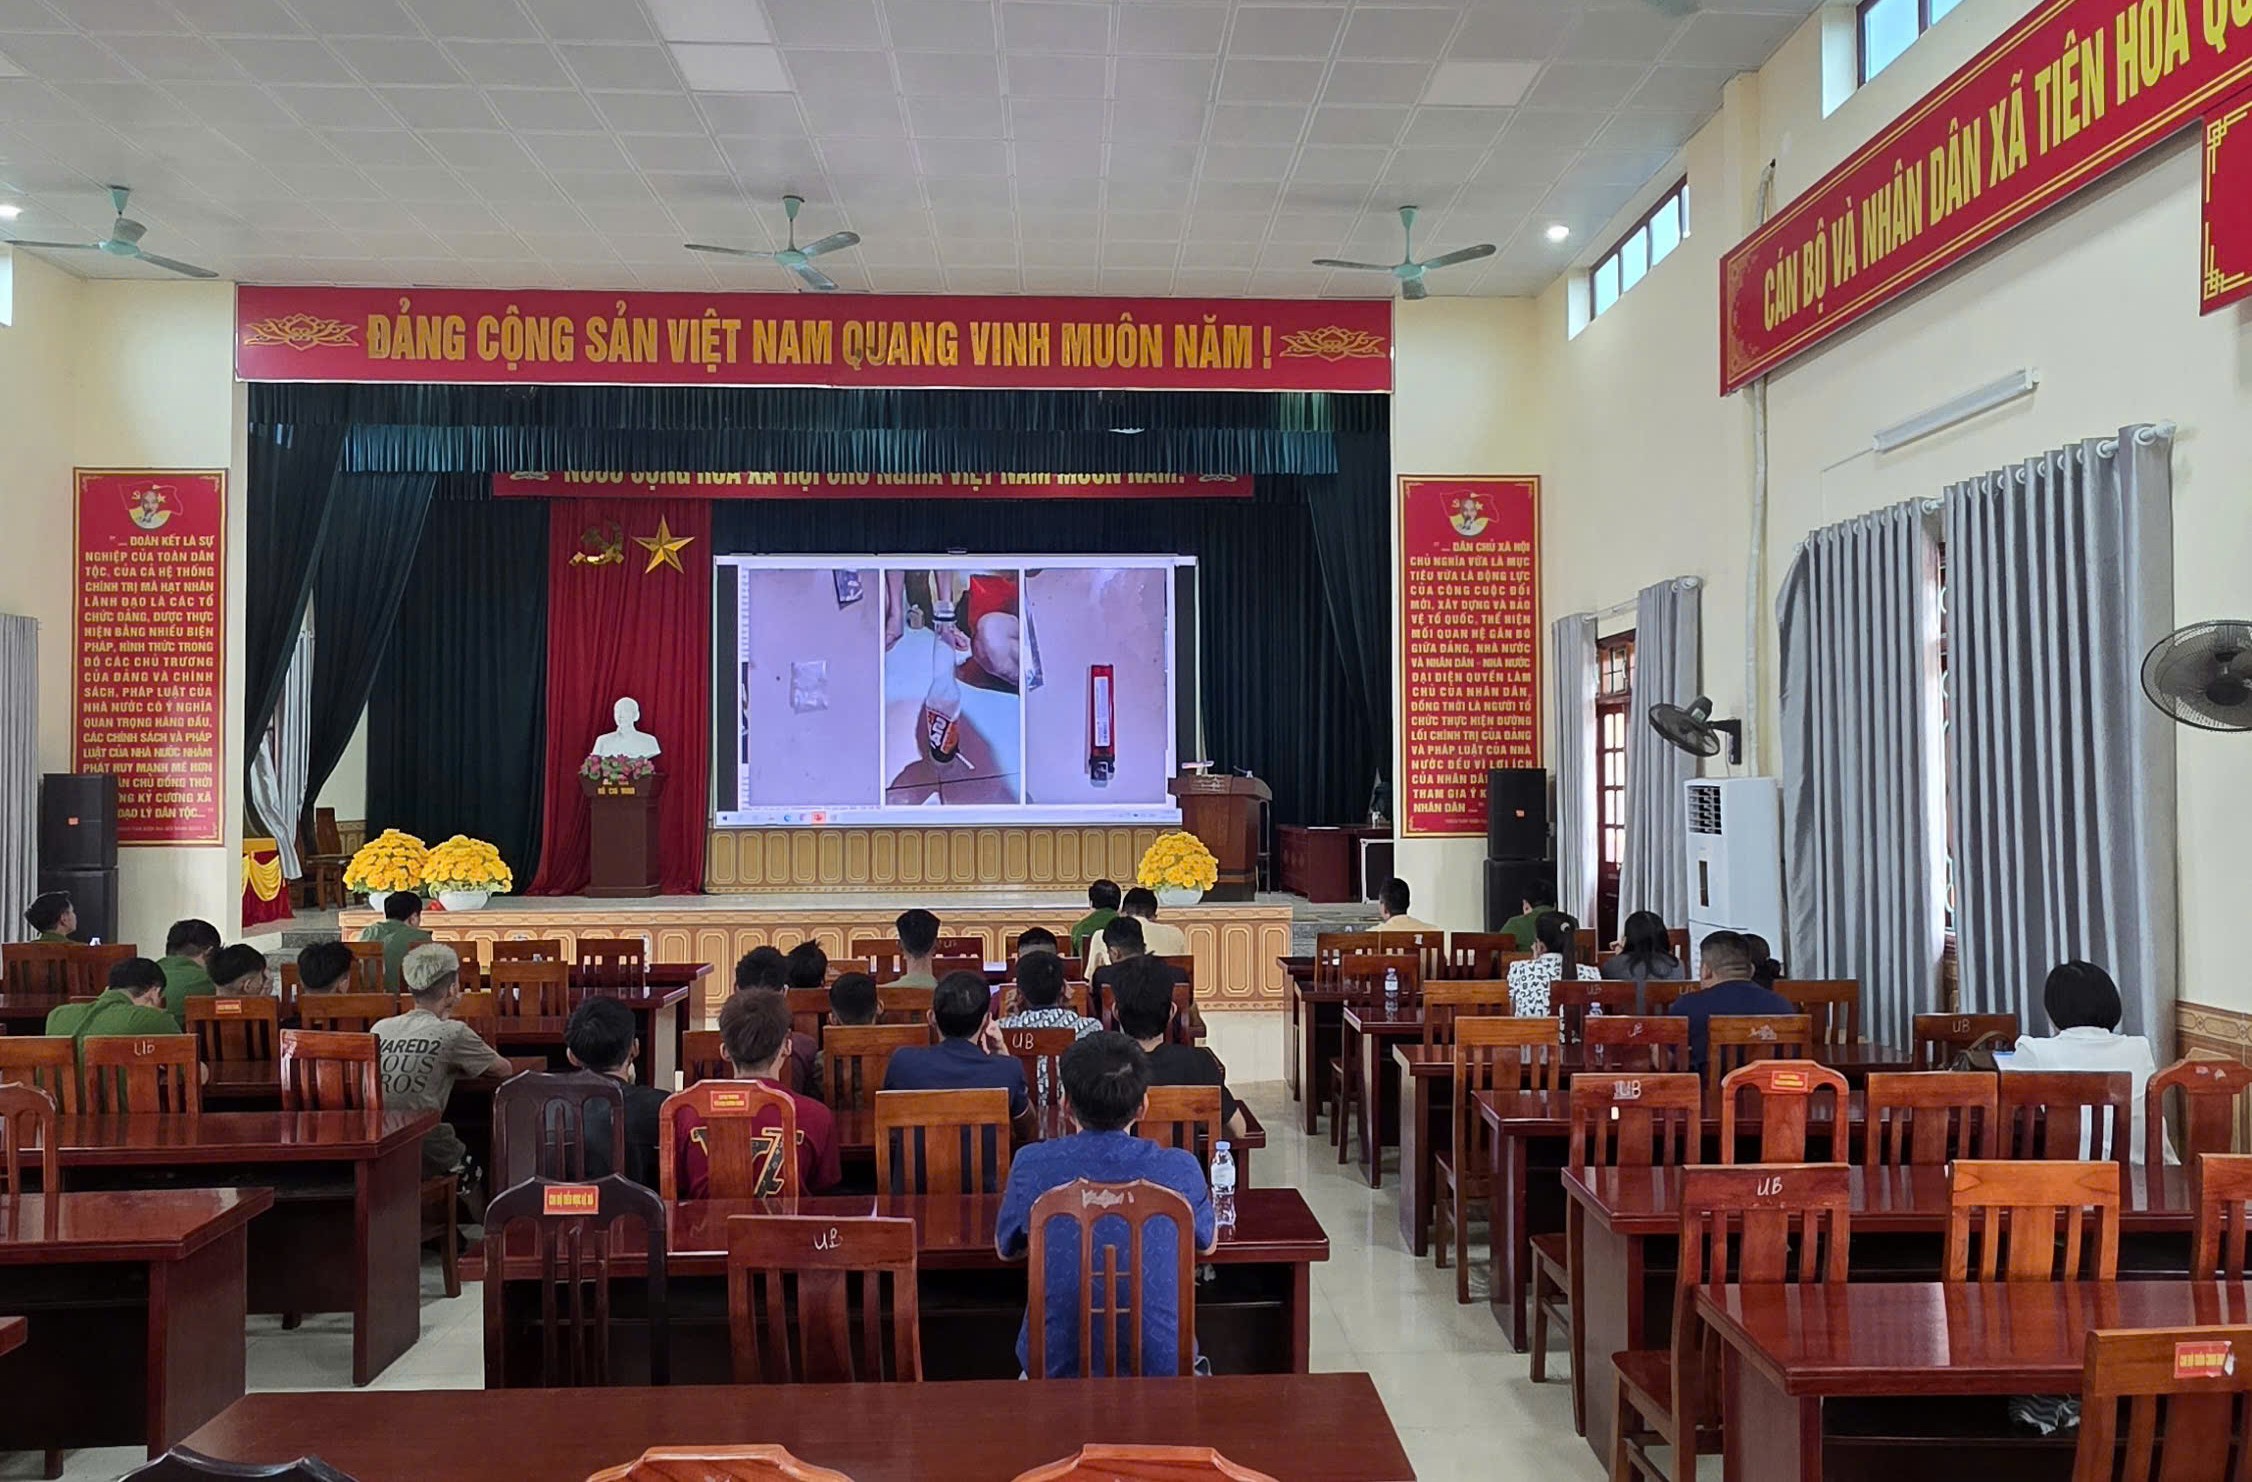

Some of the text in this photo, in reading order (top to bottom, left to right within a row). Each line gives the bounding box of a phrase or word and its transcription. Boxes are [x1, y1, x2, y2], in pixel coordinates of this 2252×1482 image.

[1763, 244, 1798, 333] CÁN
[1802, 222, 1828, 314] BỘ
[1830, 195, 1857, 288] VÀ
[1862, 156, 1924, 269] NHÂN
[1928, 115, 1981, 227] DÂN
[1988, 69, 2028, 188] XÃ
[2034, 29, 2104, 157] TIÊN
[367, 297, 465, 360] ĐẢNG
[477, 305, 574, 371] CỘNG
[585, 300, 659, 363] SẢN
[667, 308, 742, 373] VIỆT
[753, 319, 832, 365] NAM
[842, 320, 958, 371] QUANG
[970, 322, 1050, 367] VINH
[1061, 312, 1163, 369] MUÔN
[1174, 314, 1253, 369] NĂM
[1436, 629, 1468, 639] QUAN
[178, 642, 214, 652] TRONG
[84, 718, 113, 727] QUAN
[1412, 790, 1444, 799] THAM
[1447, 790, 1466, 799] GIA
[1952, 1018, 1970, 1033] UB
[1012, 1032, 1034, 1050] UB
[381, 1054, 435, 1075] OUS
[1757, 1176, 1783, 1196] UB
[813, 1227, 844, 1250] UB
